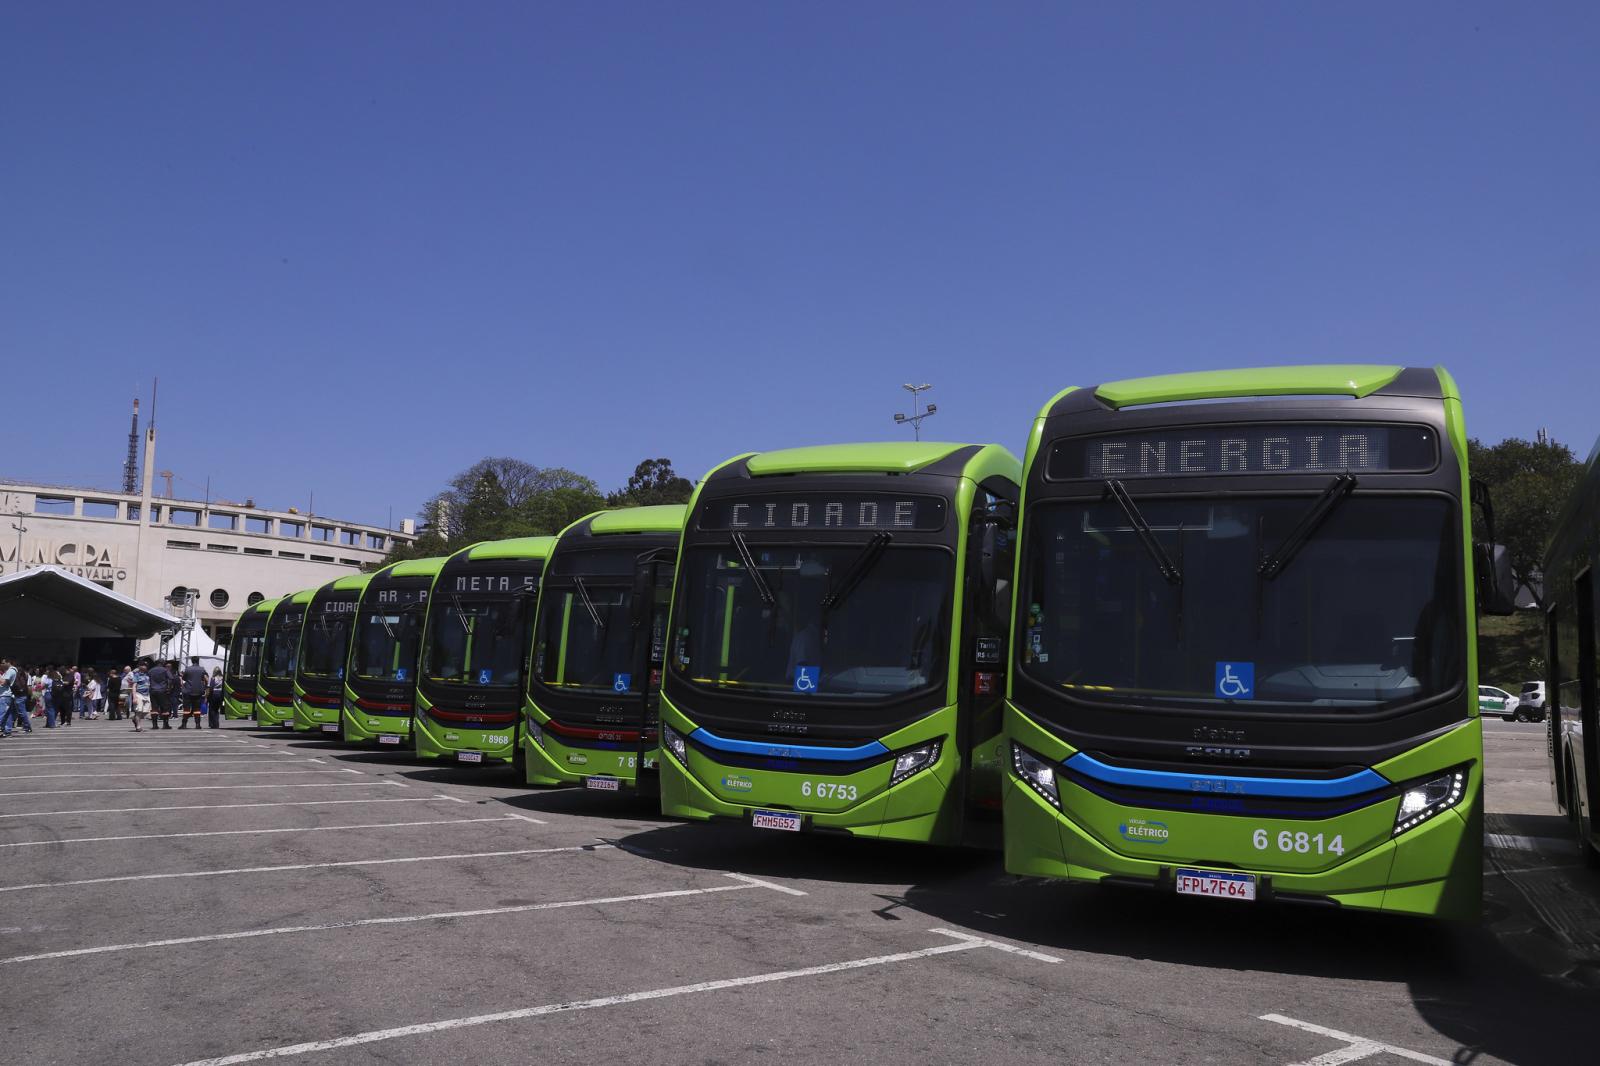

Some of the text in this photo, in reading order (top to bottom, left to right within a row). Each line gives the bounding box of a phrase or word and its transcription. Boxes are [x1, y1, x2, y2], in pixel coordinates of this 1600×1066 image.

[1101, 434, 1368, 473] ENERGIA
[730, 501, 914, 527] CIDADE
[456, 576, 510, 591] META
[378, 590, 398, 602] AR
[419, 590, 428, 603] P
[481, 734, 509, 745] 7 8968
[618, 756, 625, 768] 7
[801, 781, 857, 801] 6 6753
[1128, 826, 1169, 838] ELÉTRICO
[1253, 828, 1345, 856] 6 6814
[1182, 876, 1246, 897] FPL7F64
